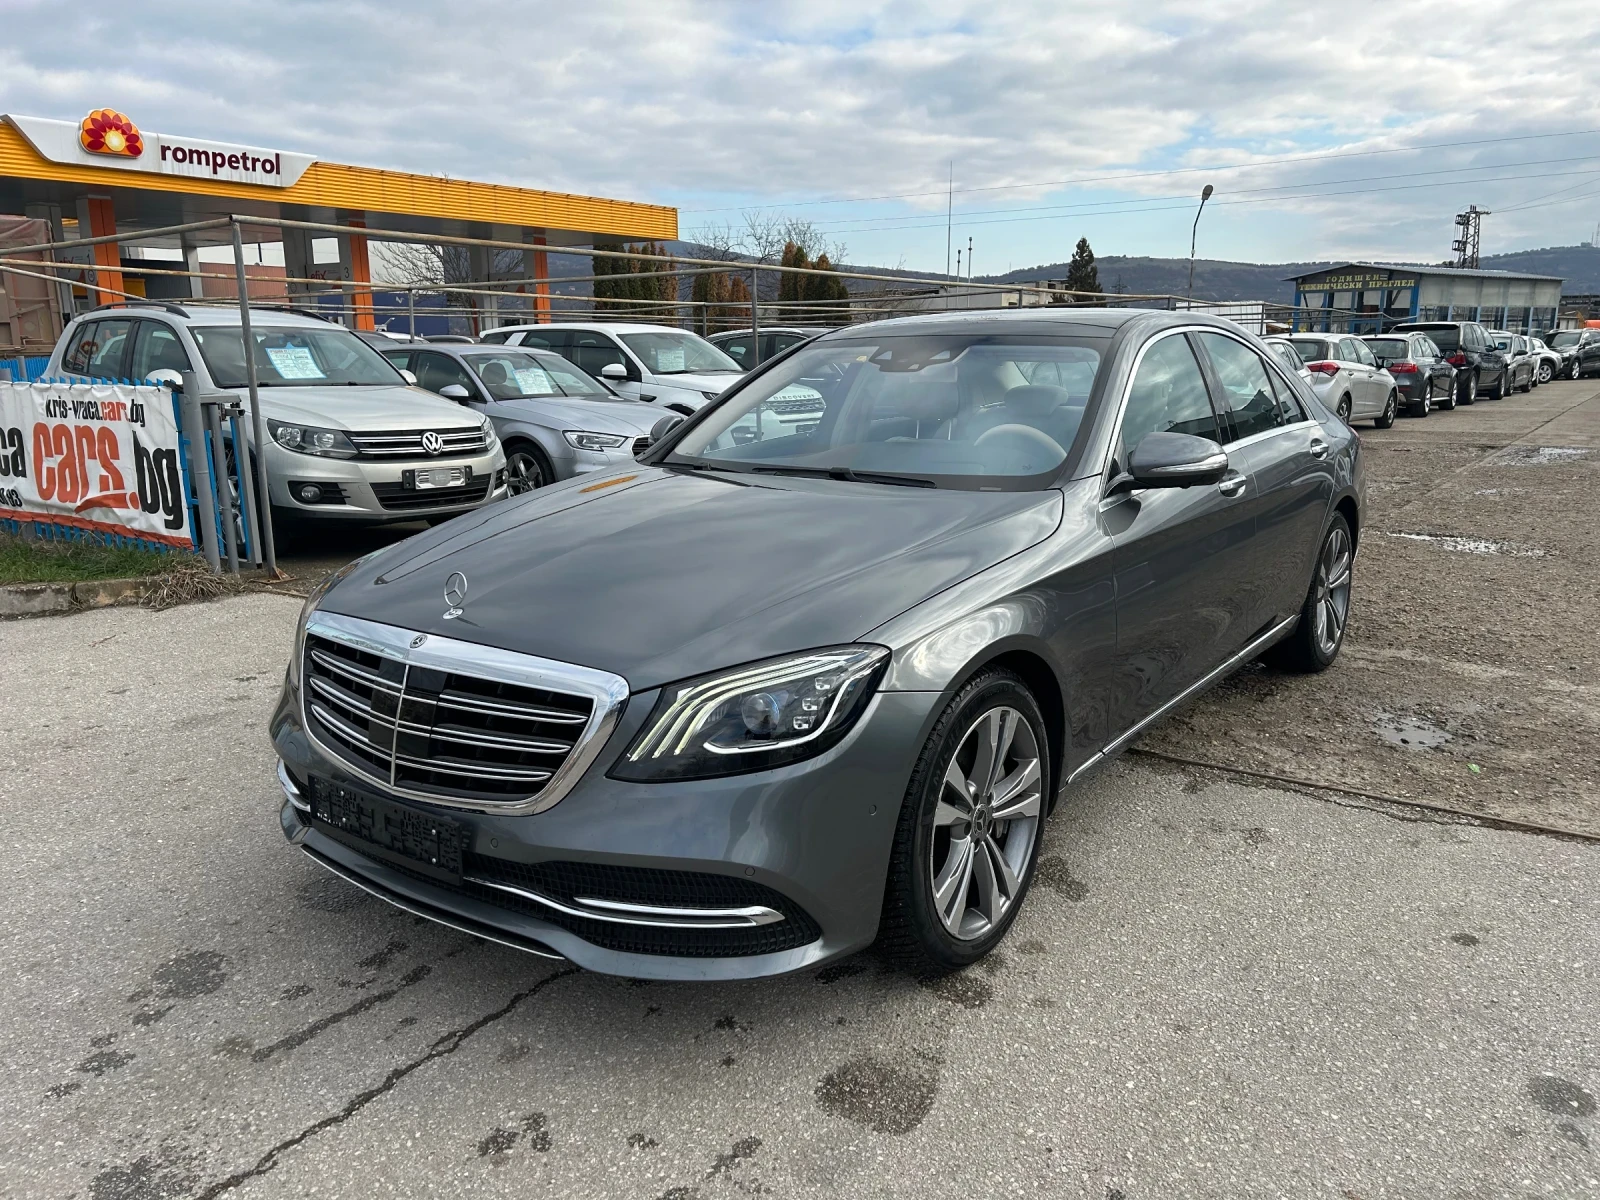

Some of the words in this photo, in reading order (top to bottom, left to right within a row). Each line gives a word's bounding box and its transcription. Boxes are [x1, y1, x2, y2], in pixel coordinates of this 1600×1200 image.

[160, 145, 280, 175] rompetrol
[343, 266, 350, 279] 3
[1299, 281, 1362, 290] ТЕХНИЧЕСКИ
[1369, 280, 1414, 288] ПРЕГЛЕД
